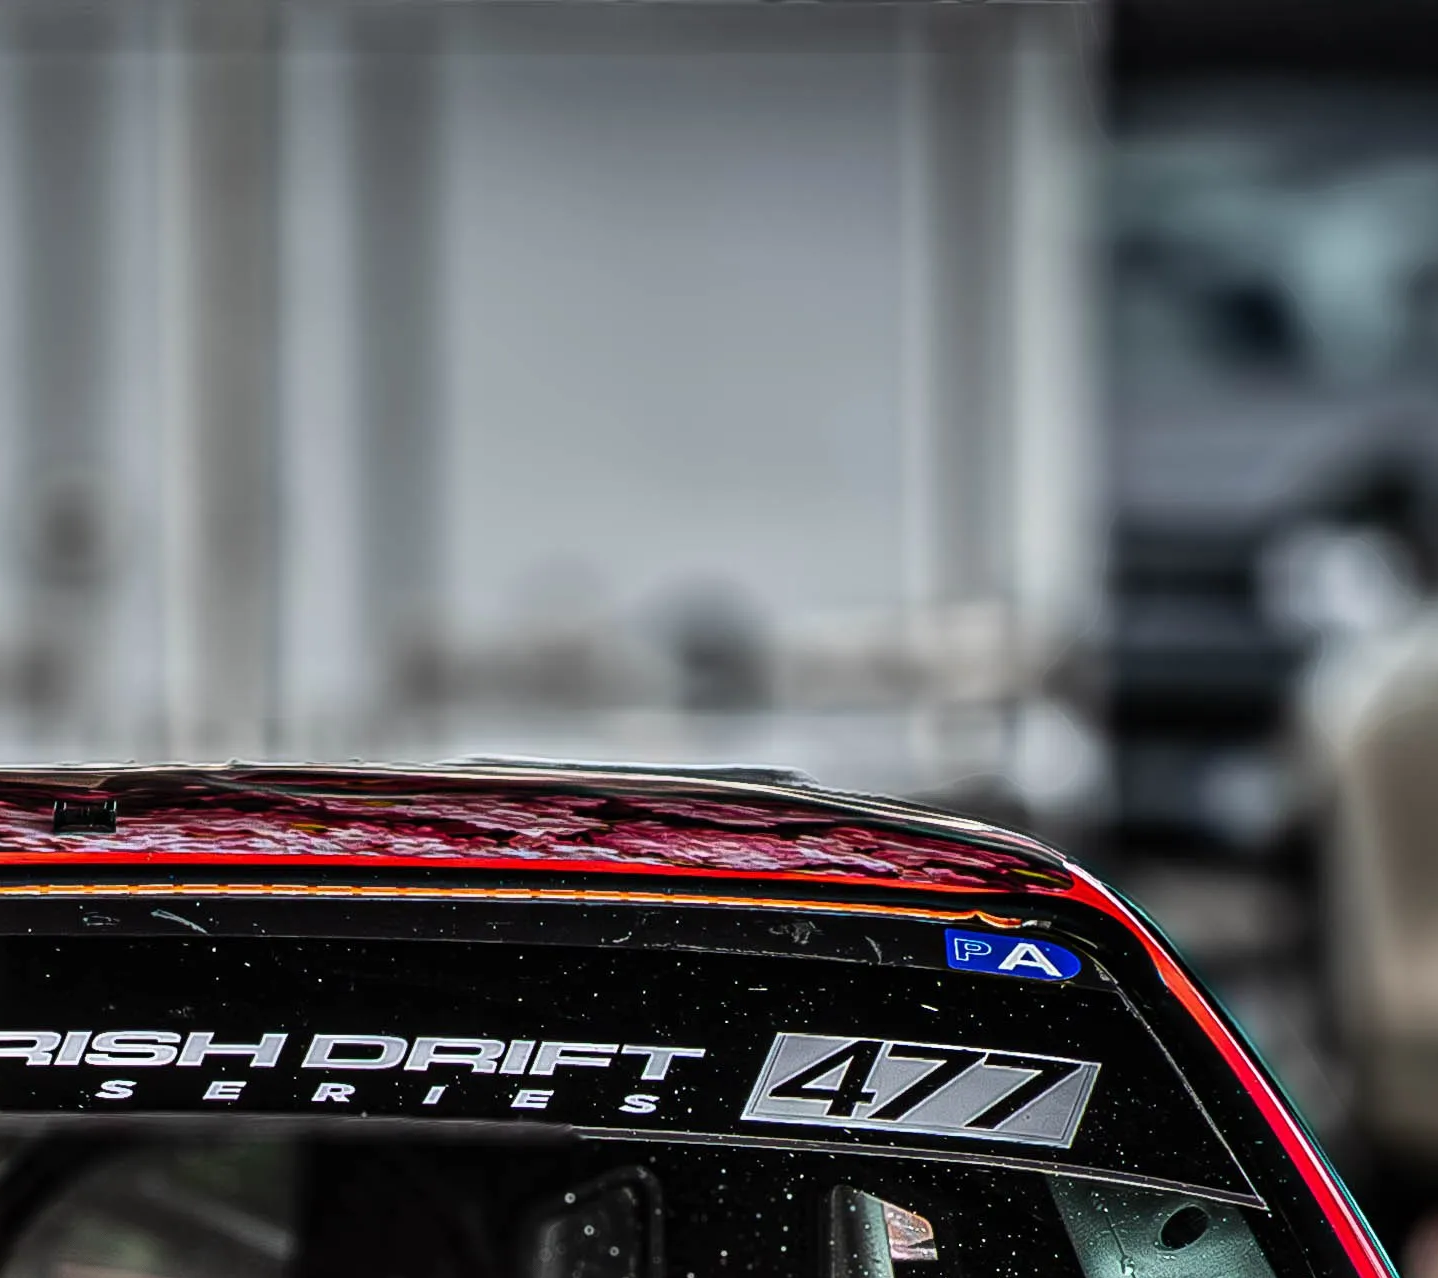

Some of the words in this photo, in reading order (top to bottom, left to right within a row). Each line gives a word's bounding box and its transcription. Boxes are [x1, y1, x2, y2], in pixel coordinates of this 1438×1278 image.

[301, 1033, 706, 1081] DRIFT
[95, 1080, 660, 1114] SERIES
[768, 1038, 1083, 1130] 477
